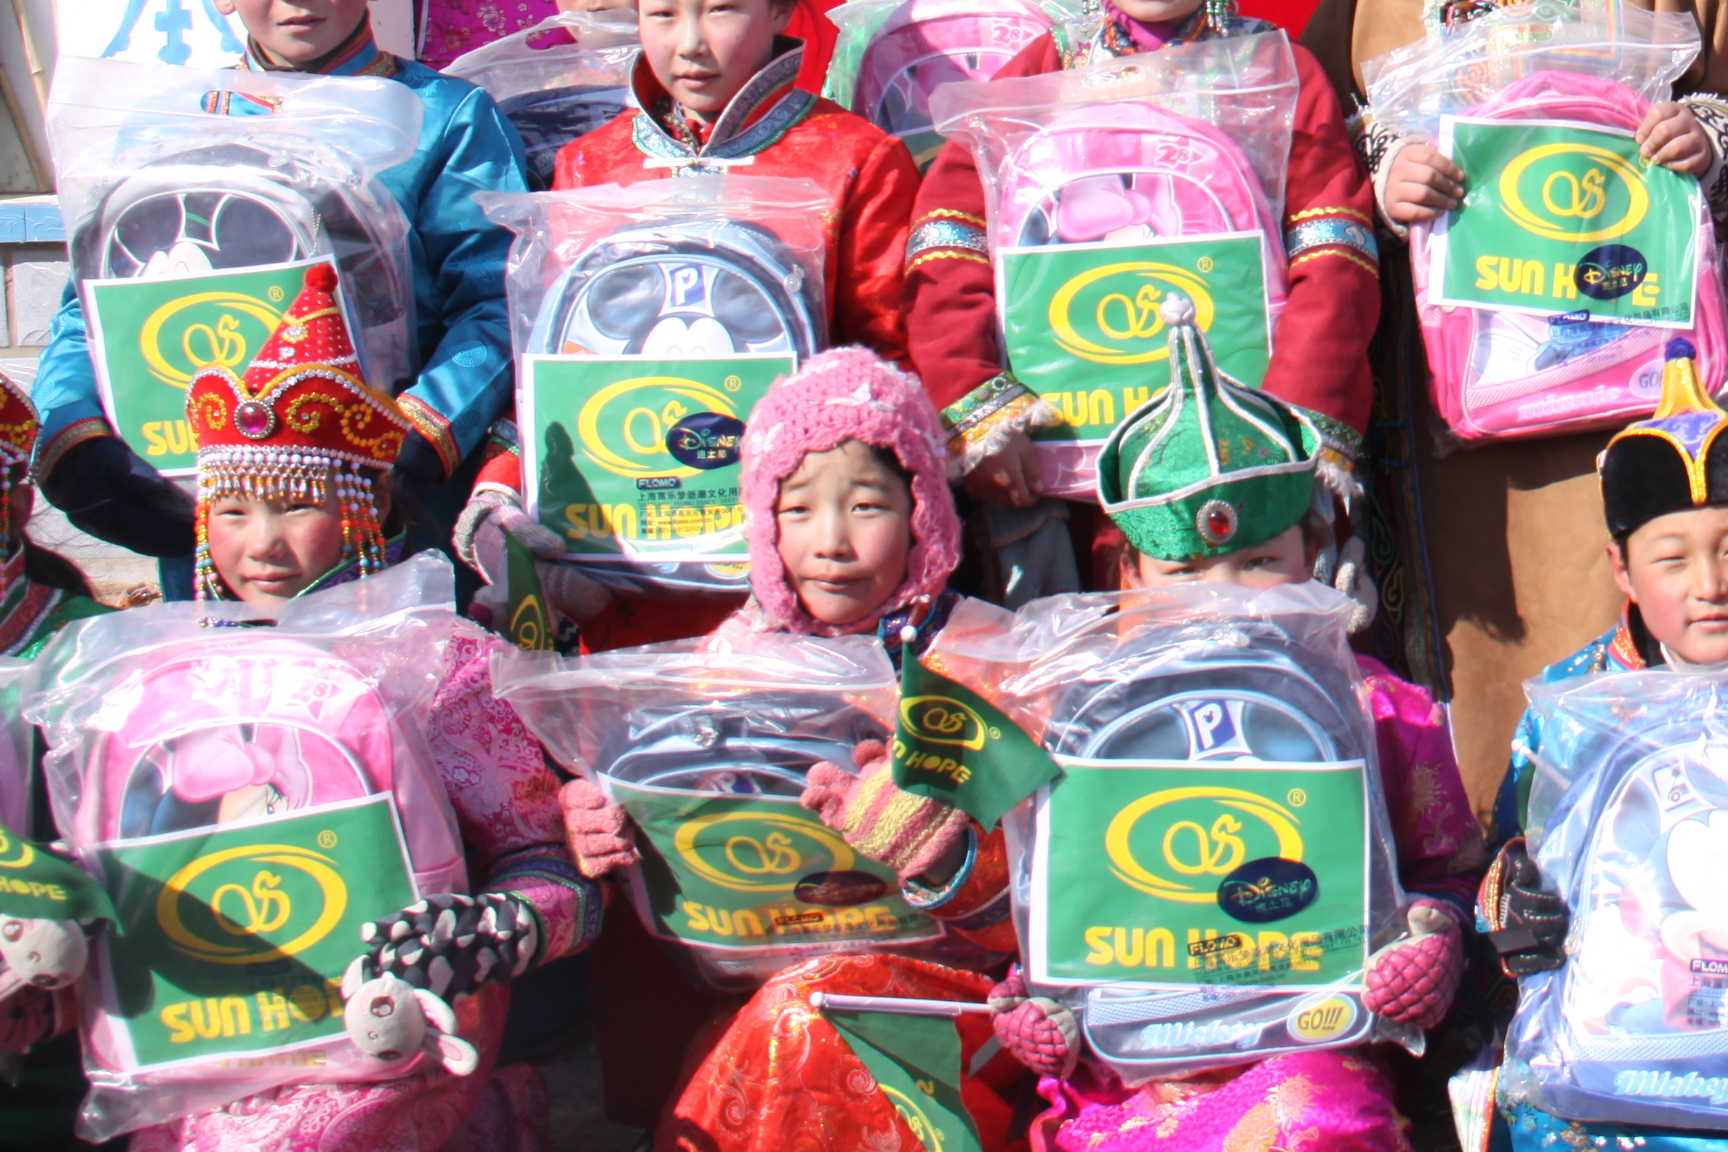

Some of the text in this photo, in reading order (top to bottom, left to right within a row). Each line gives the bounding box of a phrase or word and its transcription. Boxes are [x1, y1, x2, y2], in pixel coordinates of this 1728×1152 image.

[992, 25, 1022, 44] 28
[1156, 142, 1193, 166] 28
[674, 265, 700, 308] P
[1474, 255, 1662, 308] SUN HE
[1045, 388, 1115, 427] SUN
[141, 420, 197, 456] SU
[637, 477, 677, 489] FLOMO
[564, 503, 637, 540] SUN
[1194, 704, 1223, 751] P
[904, 750, 973, 785] HOPE
[681, 899, 763, 937] SUN
[768, 905, 898, 937] HOPE
[1083, 925, 1175, 969] SUN
[1186, 928, 1324, 971] HOPE
[160, 994, 251, 1043] SUN
[1297, 1005, 1346, 1032] GO!!!
